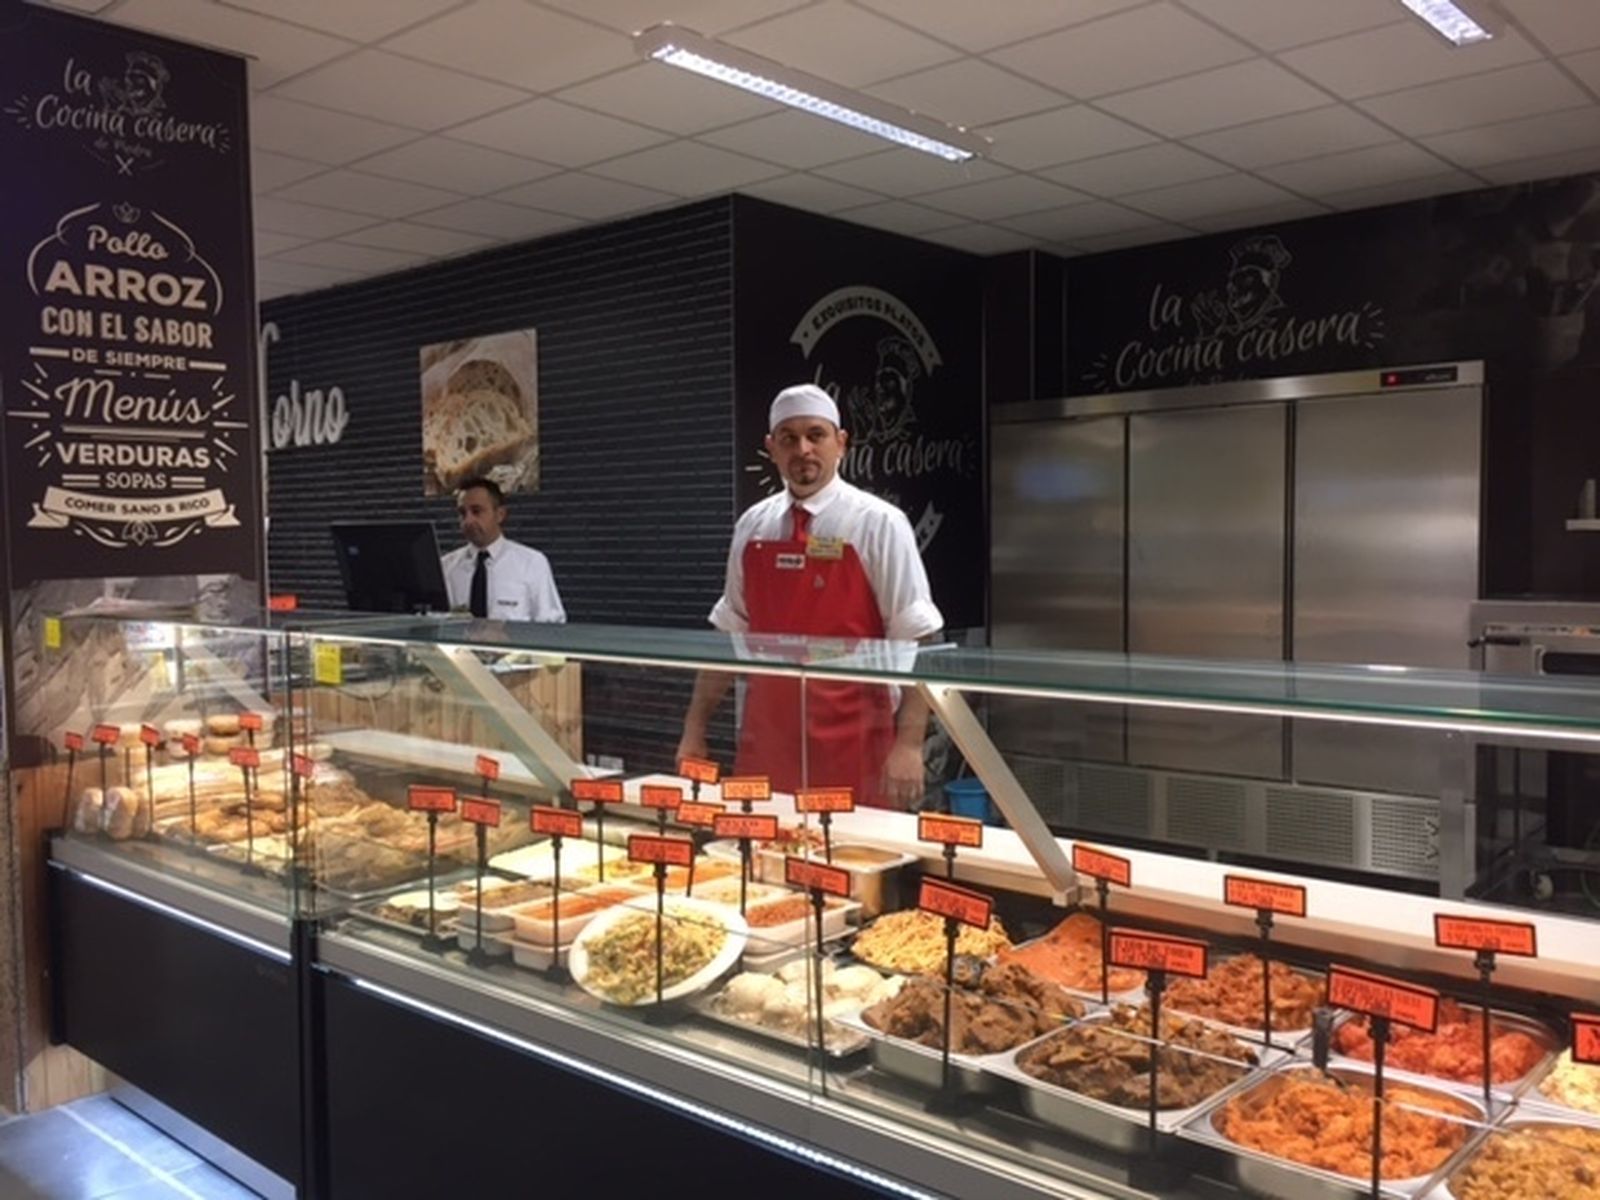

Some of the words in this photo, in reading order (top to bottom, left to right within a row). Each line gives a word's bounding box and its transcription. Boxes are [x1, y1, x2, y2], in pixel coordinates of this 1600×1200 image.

[63, 58, 92, 96] la
[35, 94, 125, 137] Cocina
[133, 115, 216, 148] casera
[87, 224, 169, 260] Pollo
[44, 260, 207, 310] ARROZ
[41, 305, 93, 338] CON
[100, 312, 127, 341] EL
[134, 316, 213, 349] SABOR
[1148, 284, 1182, 332] la
[72, 348, 98, 363] DE
[105, 351, 187, 371] SIEMPRE
[1114, 336, 1224, 388] Cocina
[1236, 309, 1362, 361] casera
[54, 377, 210, 423] Menús
[55, 442, 211, 468] VERDURAS
[105, 472, 167, 489] SOPAS
[64, 497, 116, 513] COMER
[121, 502, 161, 515] SANO
[179, 497, 210, 512] RICO
